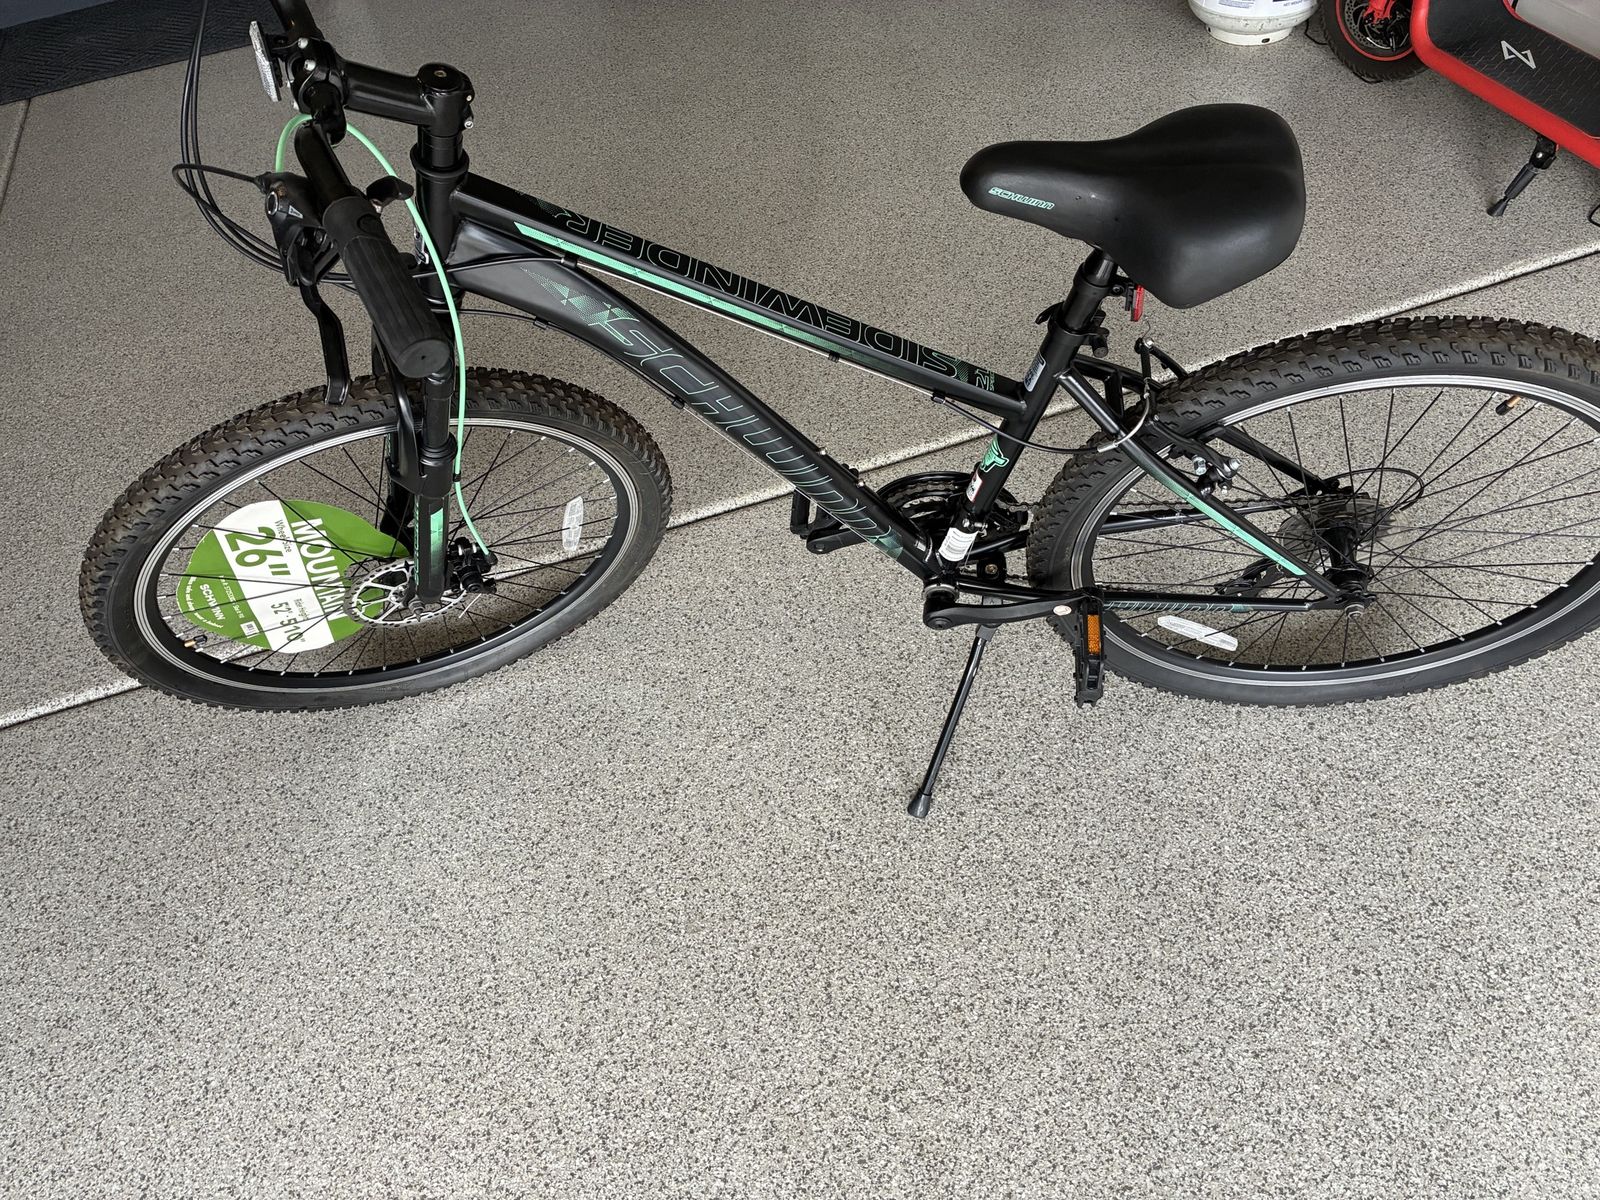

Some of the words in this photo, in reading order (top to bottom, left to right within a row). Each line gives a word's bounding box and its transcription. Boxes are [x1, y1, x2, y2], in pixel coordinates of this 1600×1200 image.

[554, 209, 958, 378] SIDEWINDER
[588, 317, 891, 538] SCHWINN
[200, 583, 225, 621] SCHWINN
[224, 526, 291, 576] 26"
[291, 518, 348, 621] MOUNTAIN
